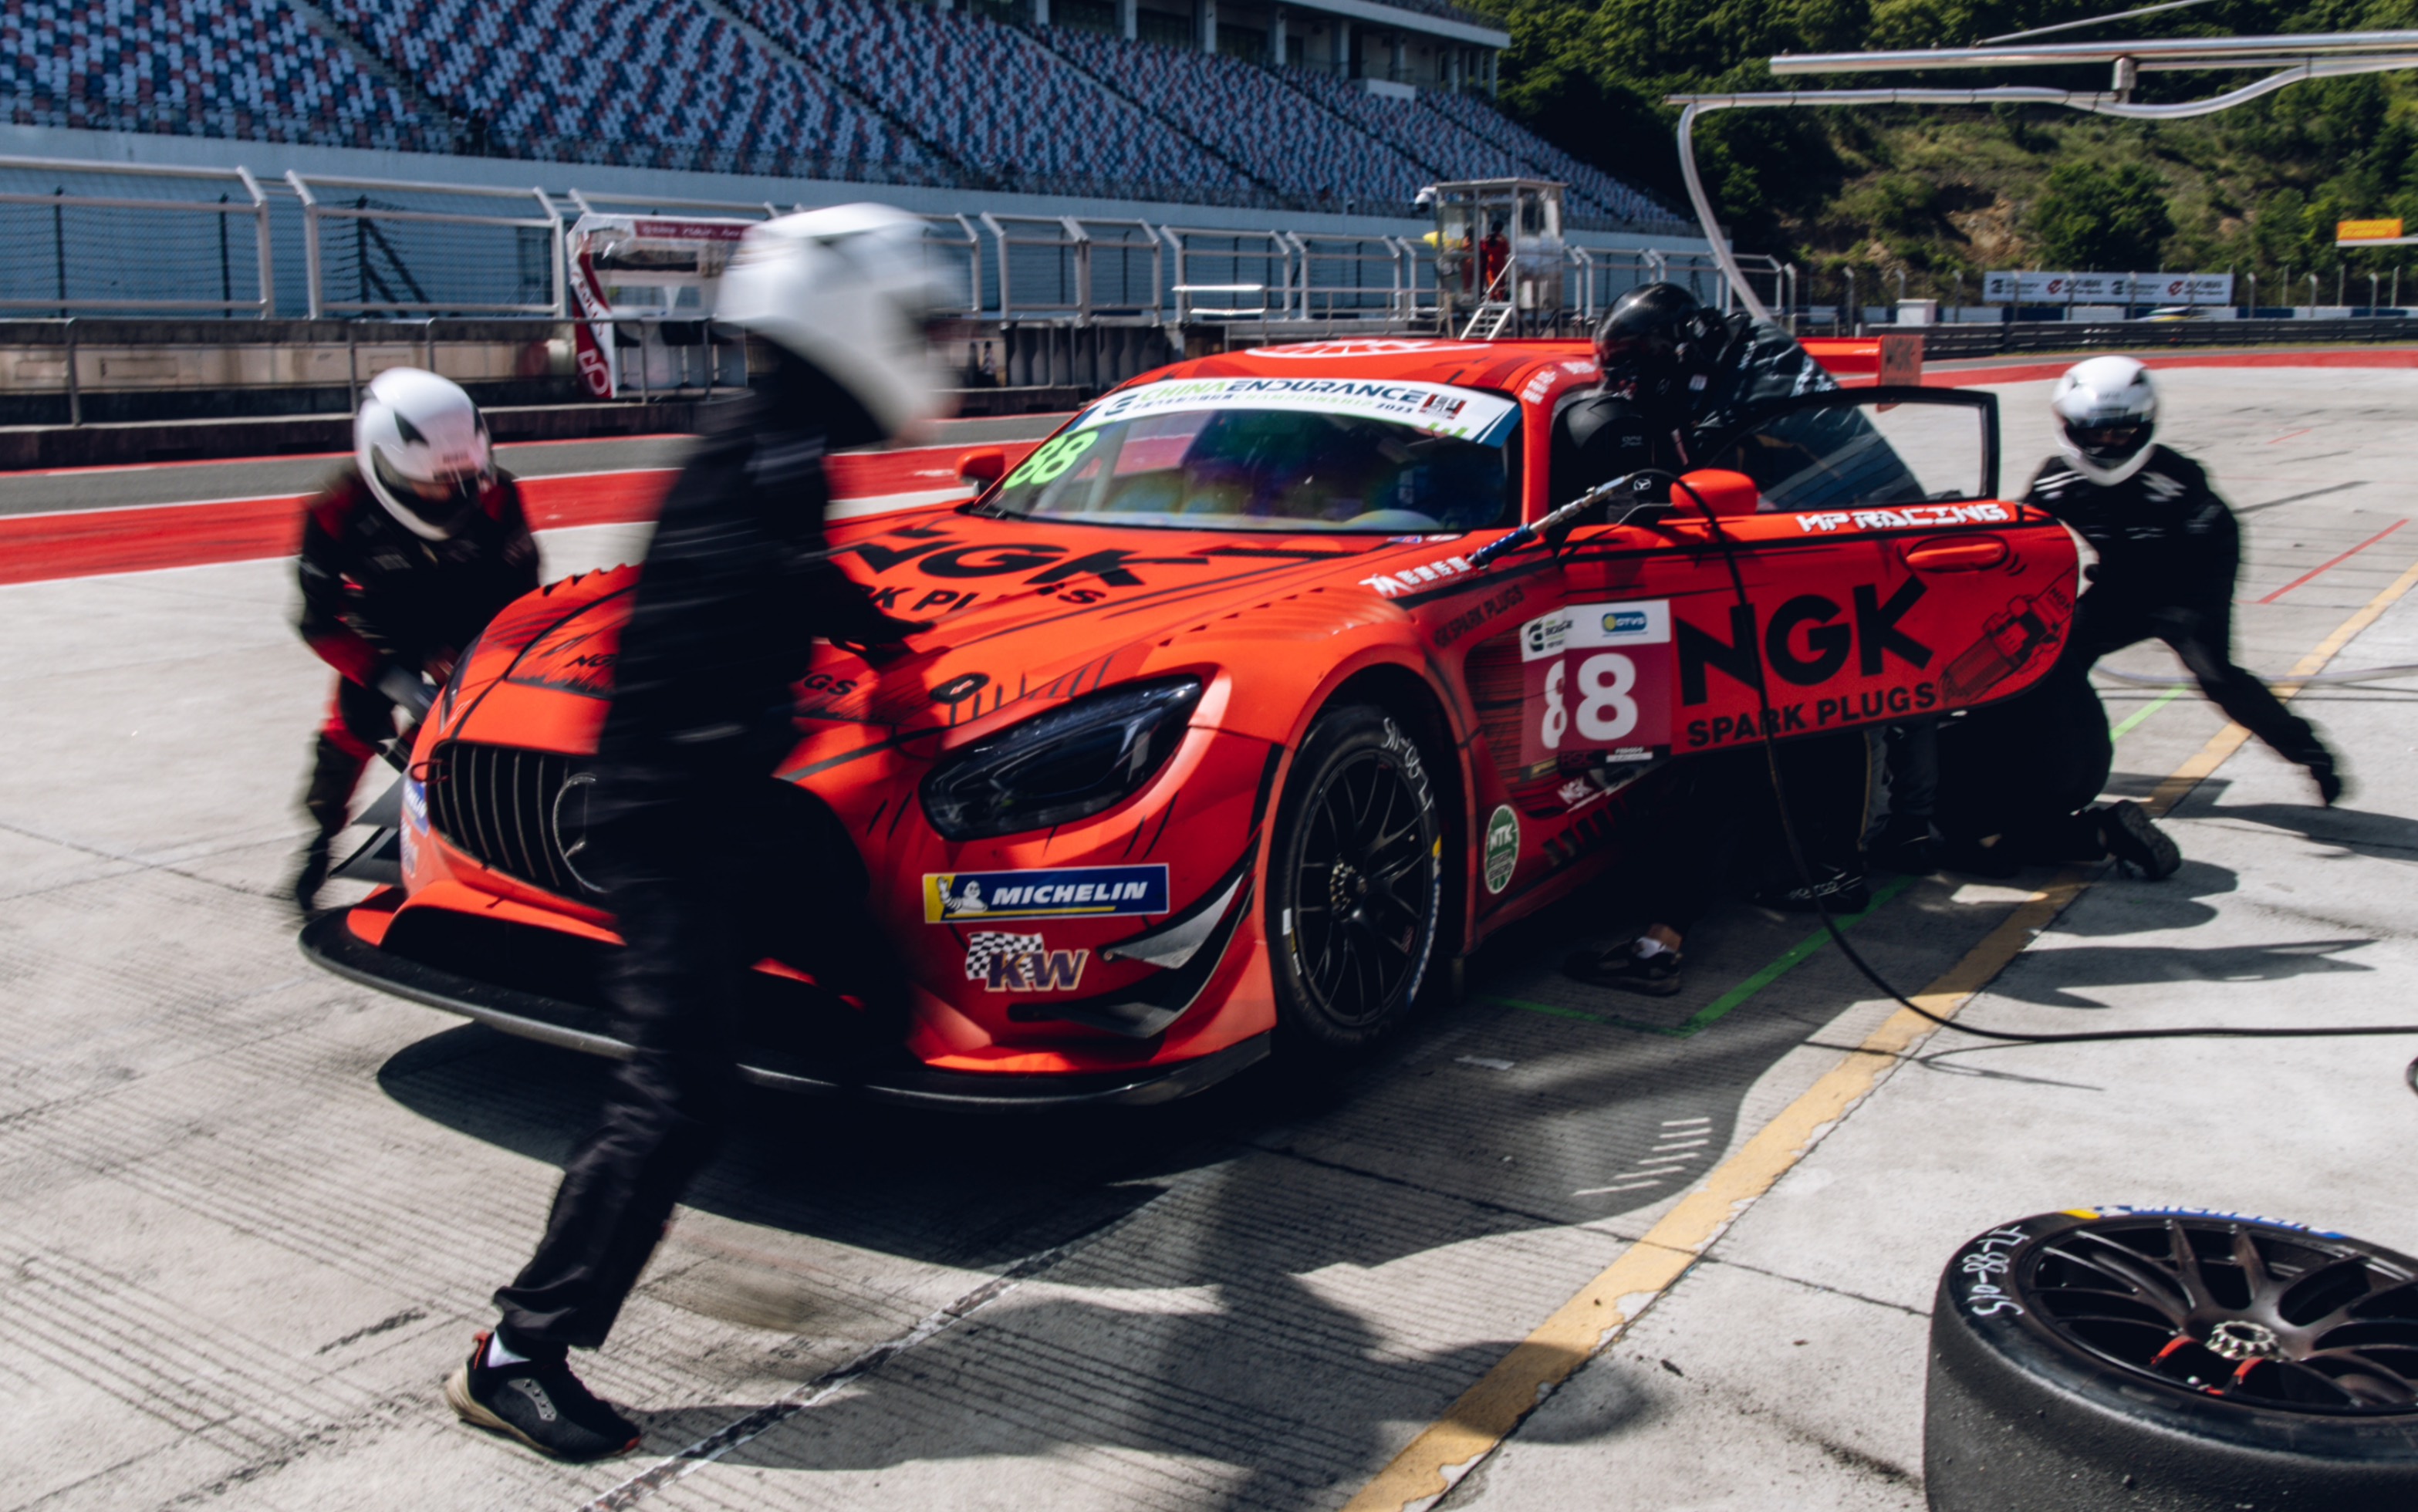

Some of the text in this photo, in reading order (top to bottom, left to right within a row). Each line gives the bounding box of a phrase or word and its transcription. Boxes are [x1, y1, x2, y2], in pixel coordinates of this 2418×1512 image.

[1141, 380, 1430, 403] CHINA ENDURANCE
[1002, 431, 1099, 490] 88
[1796, 504, 2010, 532] MP RACING
[2048, 587, 2072, 610] NGK
[1675, 575, 1934, 707] NGK
[1542, 653, 1638, 749] 88
[1687, 683, 1937, 748] SPARK PLUGS
[1557, 776, 1594, 805] NGK
[1490, 823, 1513, 851] NTK
[991, 882, 1148, 906] MICHELIN
[984, 949, 1090, 992] KW
